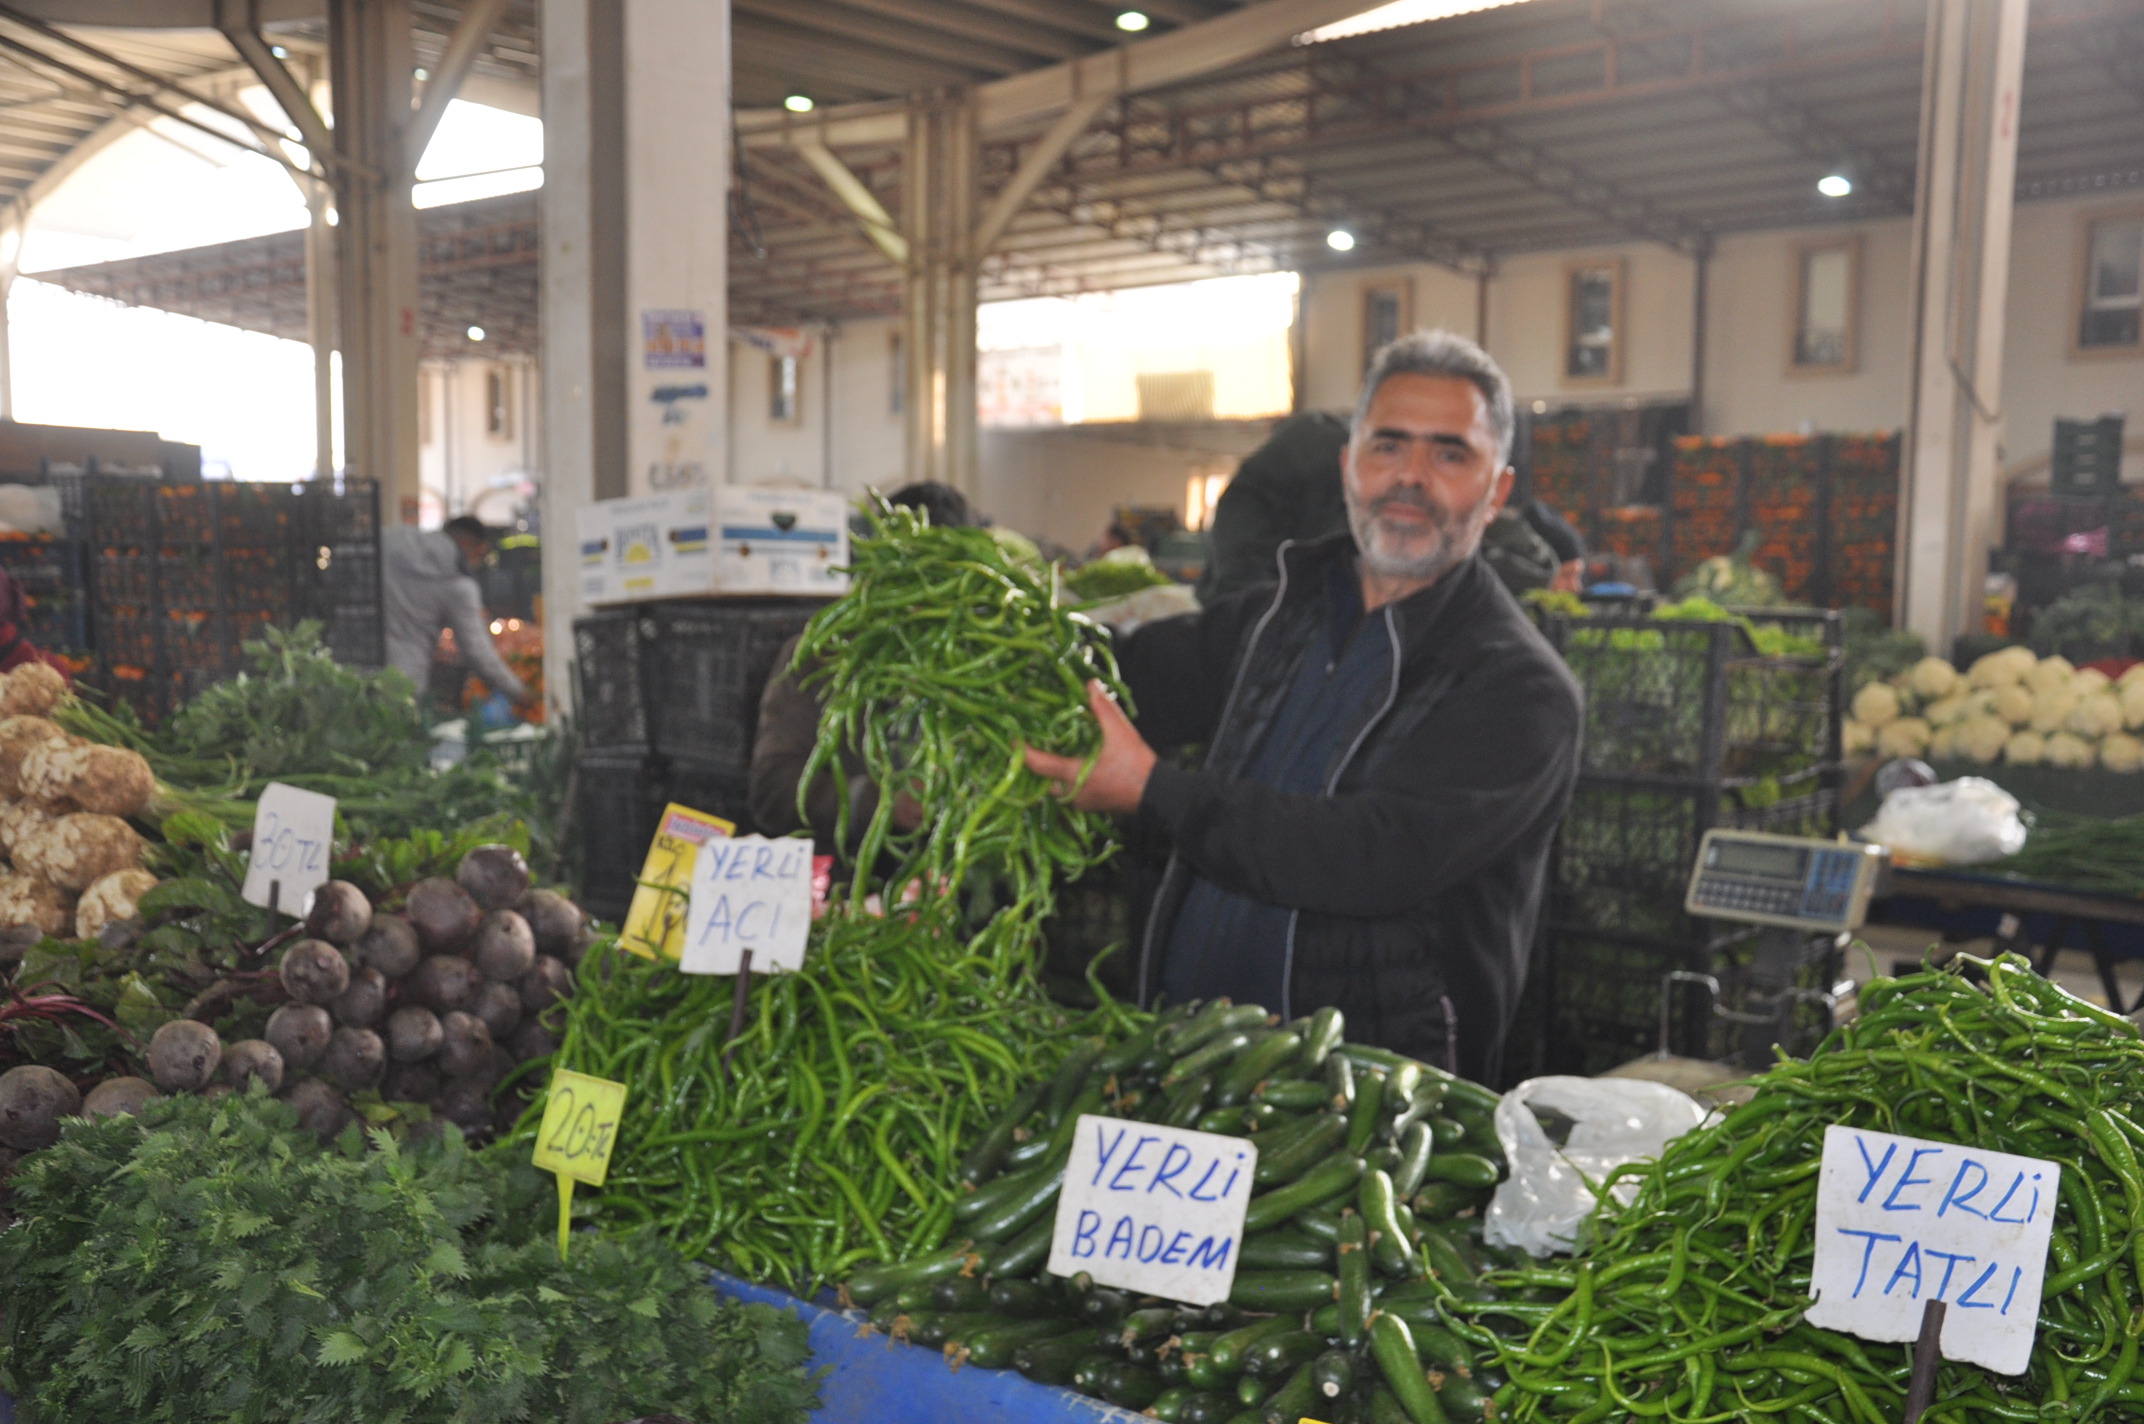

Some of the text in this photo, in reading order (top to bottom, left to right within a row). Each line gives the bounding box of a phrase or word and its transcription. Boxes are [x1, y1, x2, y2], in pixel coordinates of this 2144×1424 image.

[698, 893, 783, 946] ACI
[1071, 1208, 1233, 1271] BADEM
[1836, 1227, 2023, 1316] TATLI
